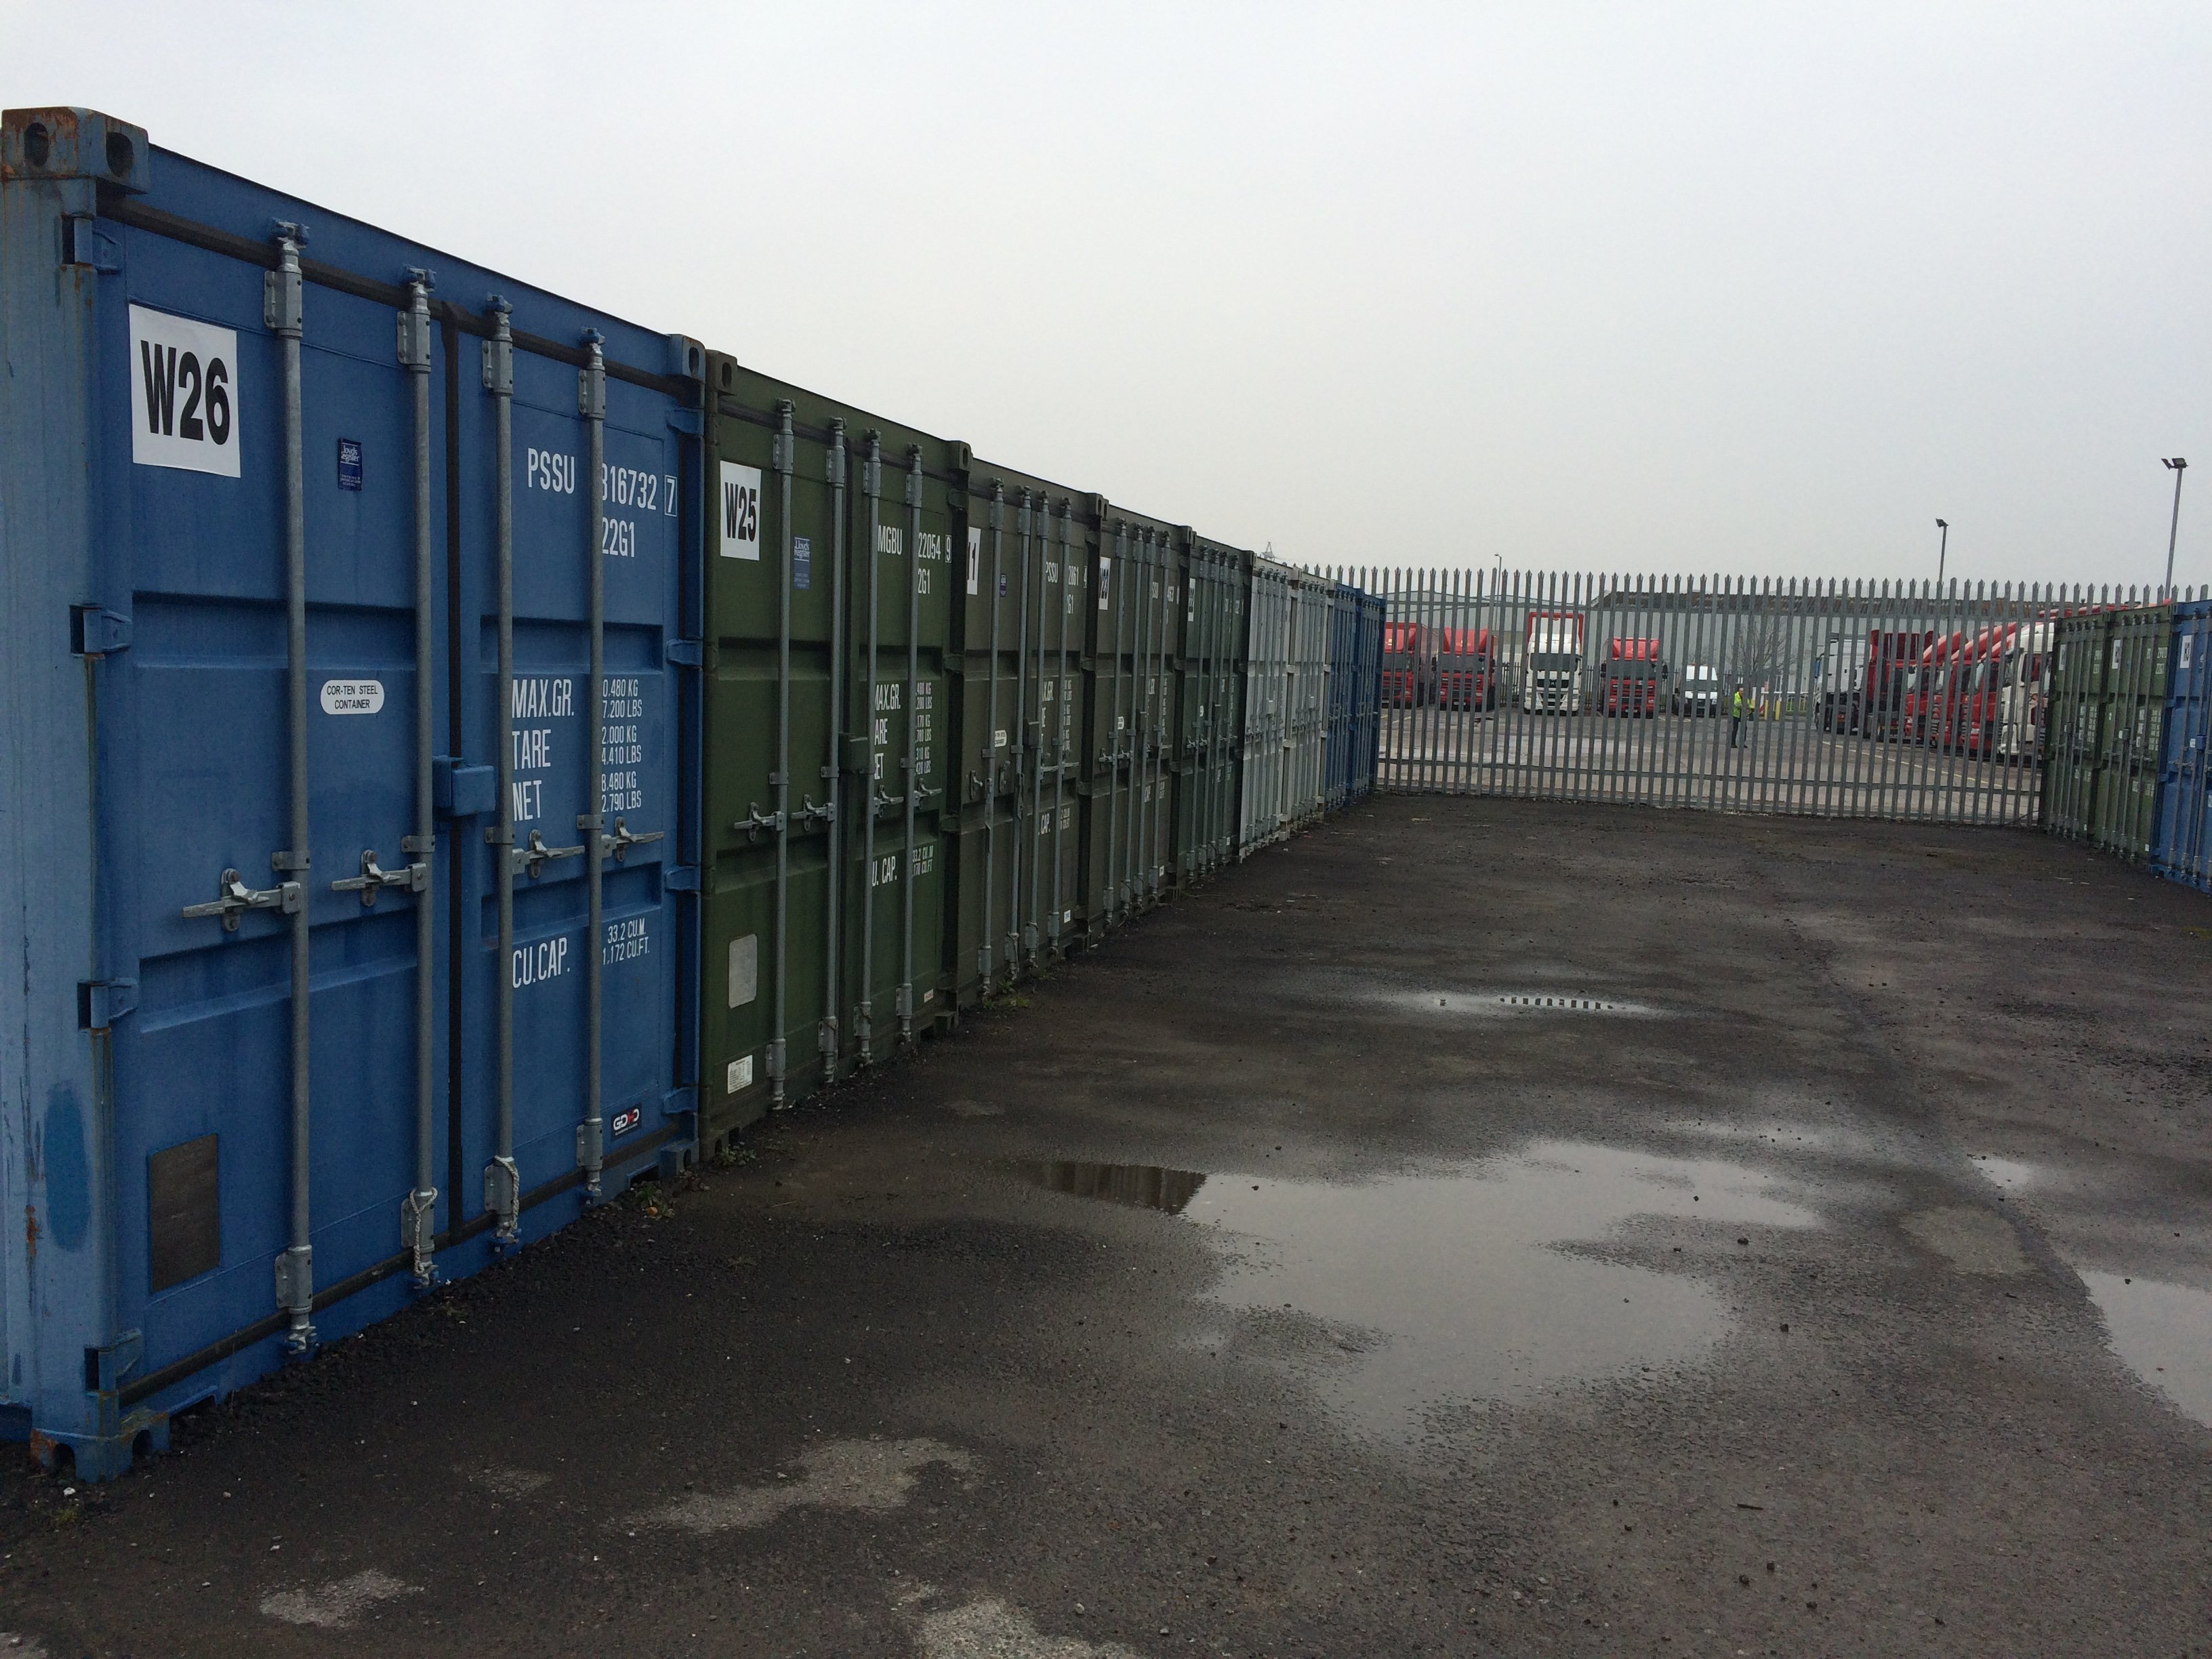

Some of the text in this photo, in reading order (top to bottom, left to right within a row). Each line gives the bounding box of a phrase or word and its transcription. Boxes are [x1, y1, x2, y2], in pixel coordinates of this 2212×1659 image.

[140, 340, 230, 445] W26
[527, 448, 575, 494] PSSU
[668, 478, 675, 513] 7
[724, 482, 756, 542] W25
[602, 517, 635, 557] 22G1
[878, 525, 903, 555] MGBU
[918, 532, 941, 560] 22054
[918, 568, 930, 594] 2G1
[327, 685, 378, 695] COR-TEN STEEL
[335, 699, 370, 709] CONTAINER
[512, 679, 638, 718] MAX.GR. 0,480 KG
[602, 699, 642, 718] 7,200 LBS
[875, 718, 888, 745] ARE
[512, 729, 551, 770] TARE
[627, 724, 637, 743] KG
[626, 744, 642, 764] LBS
[512, 771, 637, 821] NET 8,480 KG
[601, 790, 642, 813] 2,790 LBS
[882, 855, 897, 884] CAP.
[608, 922, 625, 943] 33.2
[603, 937, 650, 965] 1,172 CU.FT.
